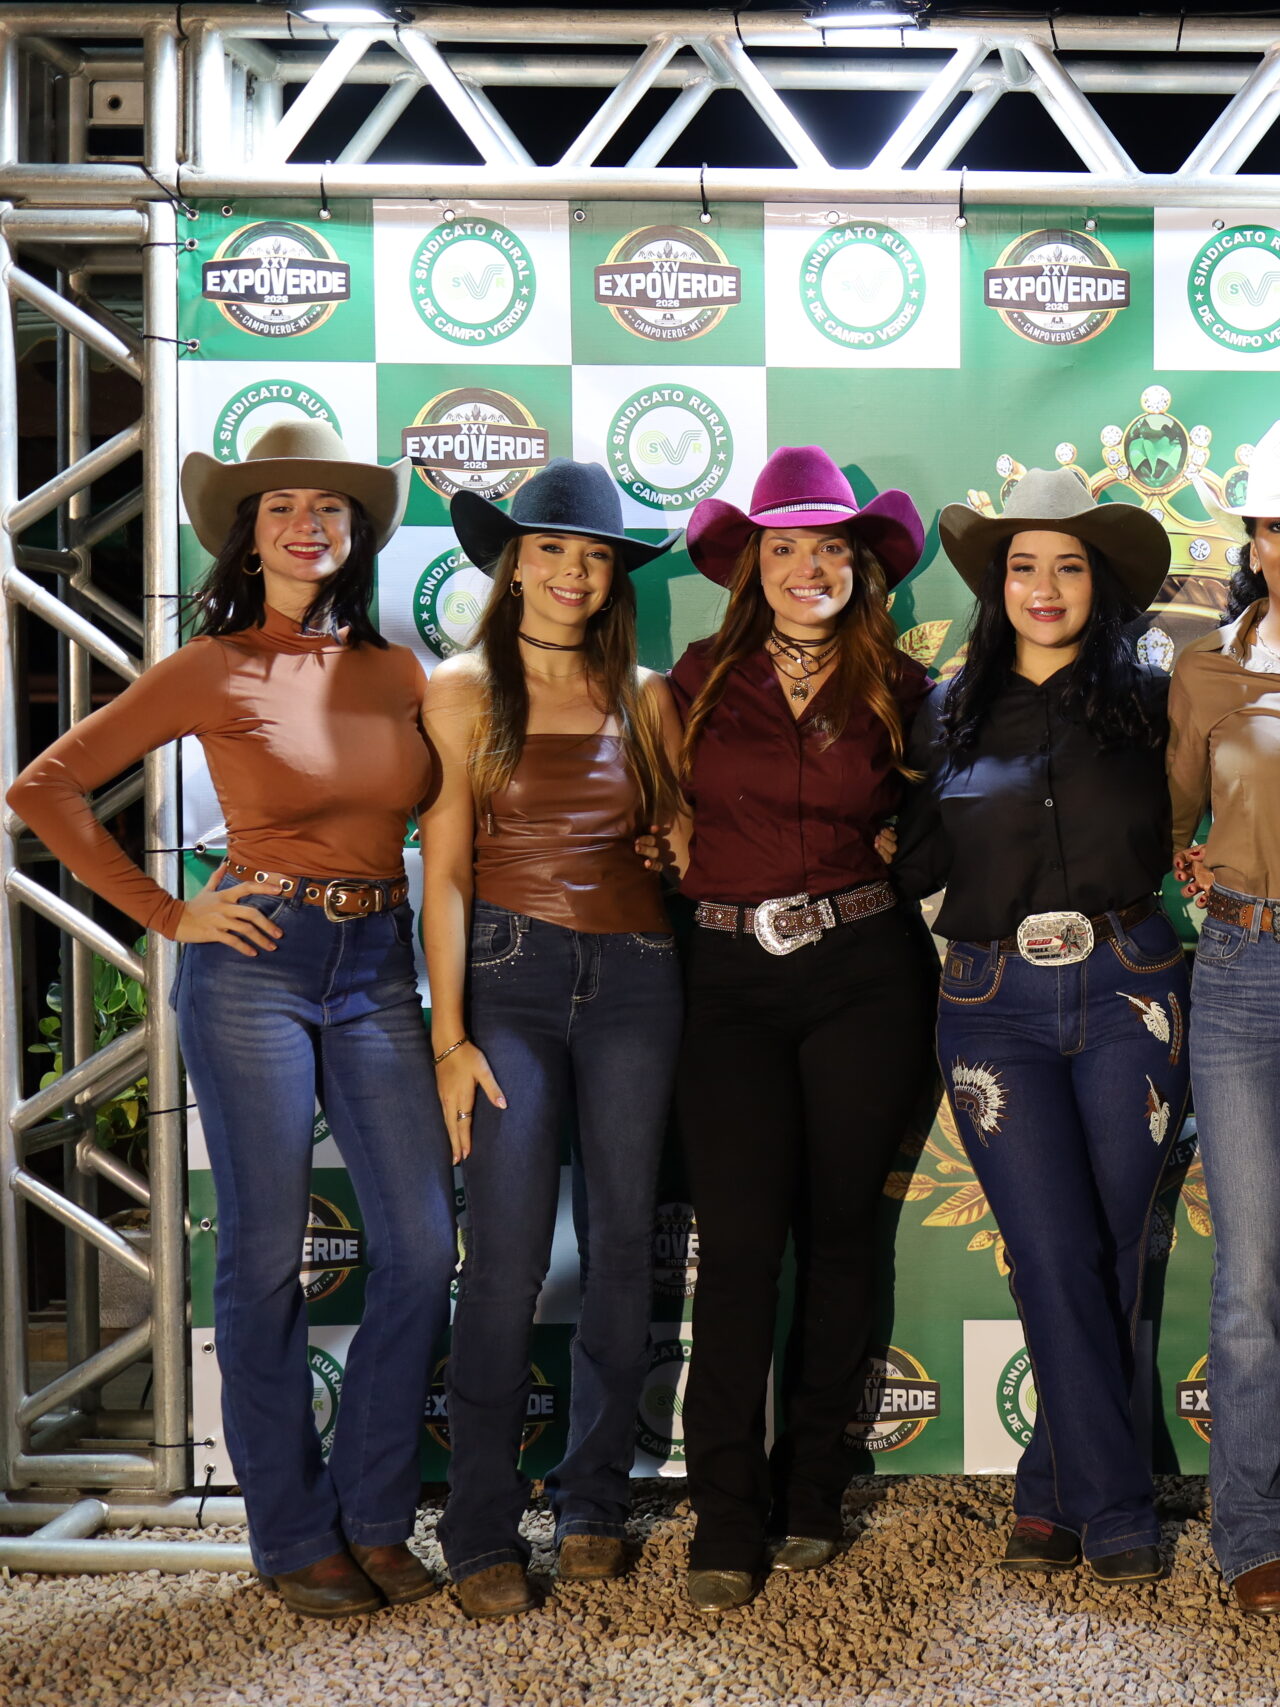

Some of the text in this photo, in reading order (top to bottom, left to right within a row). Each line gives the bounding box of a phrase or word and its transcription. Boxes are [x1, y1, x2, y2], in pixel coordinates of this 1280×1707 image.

[261, 257, 289, 269] XXV
[415, 223, 530, 281] SINDICATO RURAL
[805, 226, 921, 285] SINDICATO RURAL
[1194, 230, 1266, 287] SINDICATO
[652, 261, 680, 273] XXV
[1042, 265, 1070, 277] XXV
[206, 268, 346, 295] EXPOVERDE
[599, 272, 737, 299] EXPOVERDE
[988, 276, 1126, 302] EXPOVERDE
[264, 295, 289, 303] 2026
[655, 299, 680, 308] 2026
[1045, 303, 1069, 311] 2026
[242, 315, 270, 334] CAMPO
[420, 297, 528, 341] DE CAMPO VERDE
[634, 319, 661, 338] CAMPO
[809, 301, 917, 345] DE CAMPO VERDE
[1197, 304, 1215, 326] DE
[1212, 322, 1263, 348] CAMPO
[1023, 323, 1050, 342] CAMPO
[220, 385, 329, 441] SINDICATO RUR
[612, 390, 728, 446] SINDICATO RURAL
[460, 424, 488, 435] XXV
[406, 435, 545, 461] EXPOVERDE
[463, 461, 488, 469] 2026
[480, 482, 510, 499] RDE-MT
[617, 463, 724, 506] DE CAMPO VERDE
[420, 552, 471, 606] SINDICA
[424, 623, 442, 644] DE
[1003, 1353, 1031, 1396] SINDI
[861, 1388, 936, 1413] VERDE
[1006, 1413, 1024, 1433] DE
